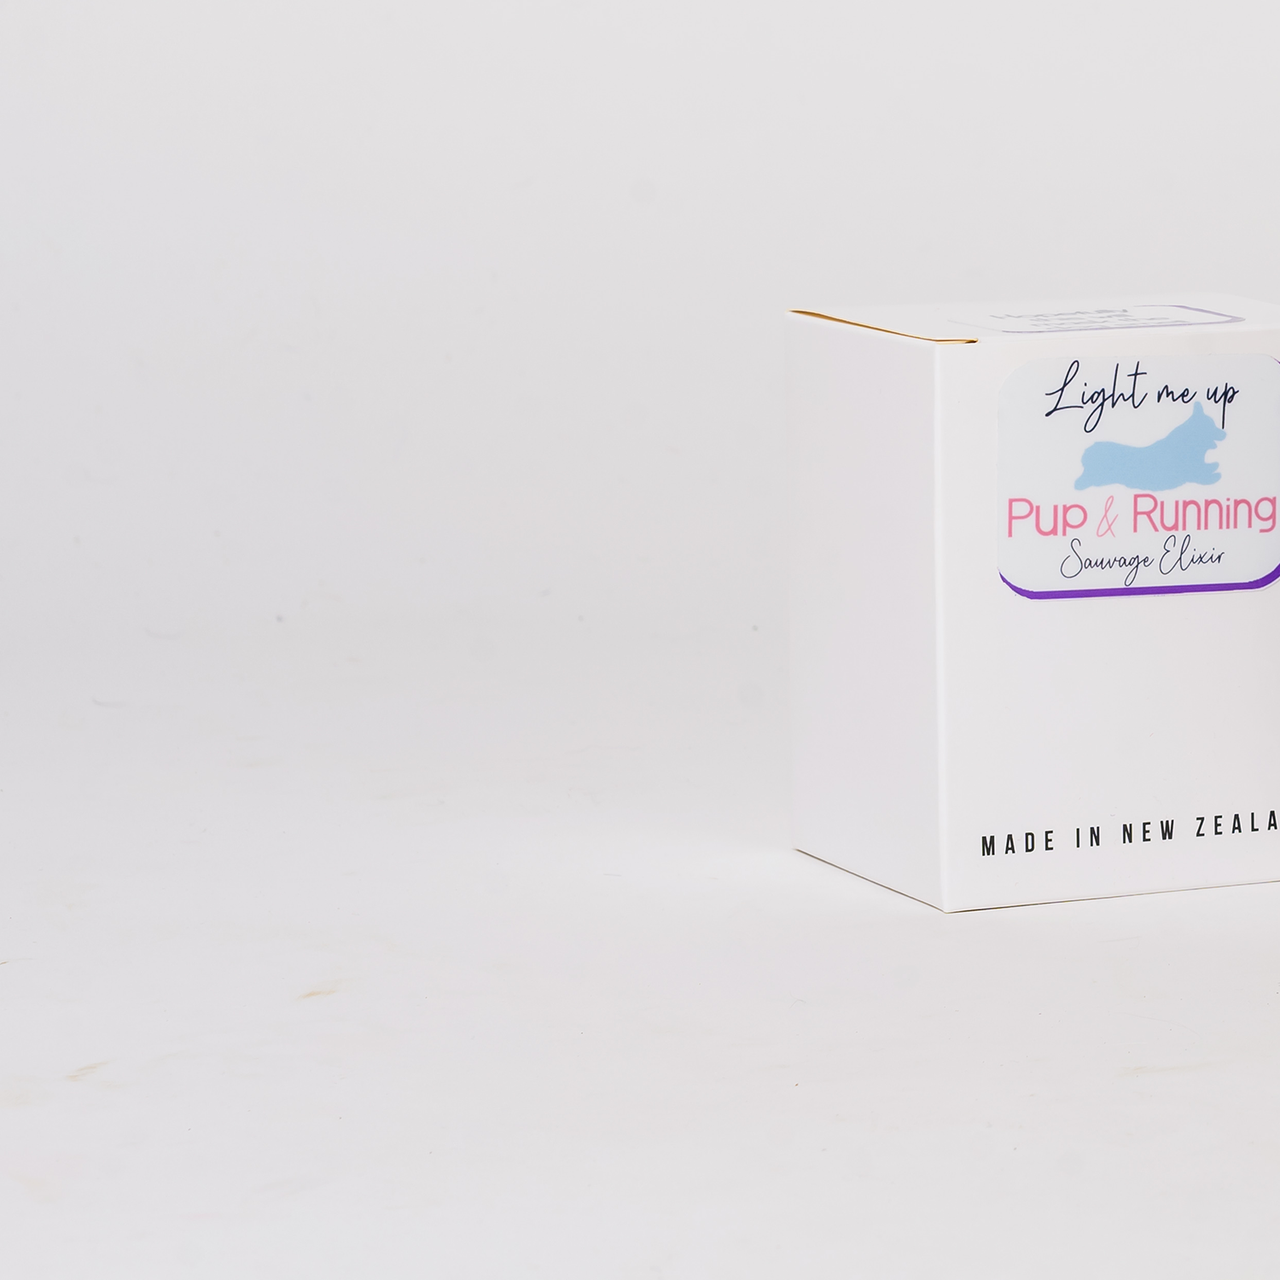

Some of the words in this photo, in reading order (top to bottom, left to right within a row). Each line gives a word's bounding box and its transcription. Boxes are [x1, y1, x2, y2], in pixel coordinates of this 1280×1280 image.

[1045, 360, 1148, 433] Light
[1157, 384, 1198, 404] me
[1206, 383, 1240, 430] up
[1007, 497, 1088, 538] Pup
[1096, 495, 1119, 538] &
[1132, 493, 1277, 534] Running
[1060, 538, 1155, 586] Sauvage
[1159, 534, 1225, 575] Elixir
[981, 830, 1054, 856] MADE
[1076, 826, 1101, 848] IN
[1122, 820, 1175, 844] NEW
